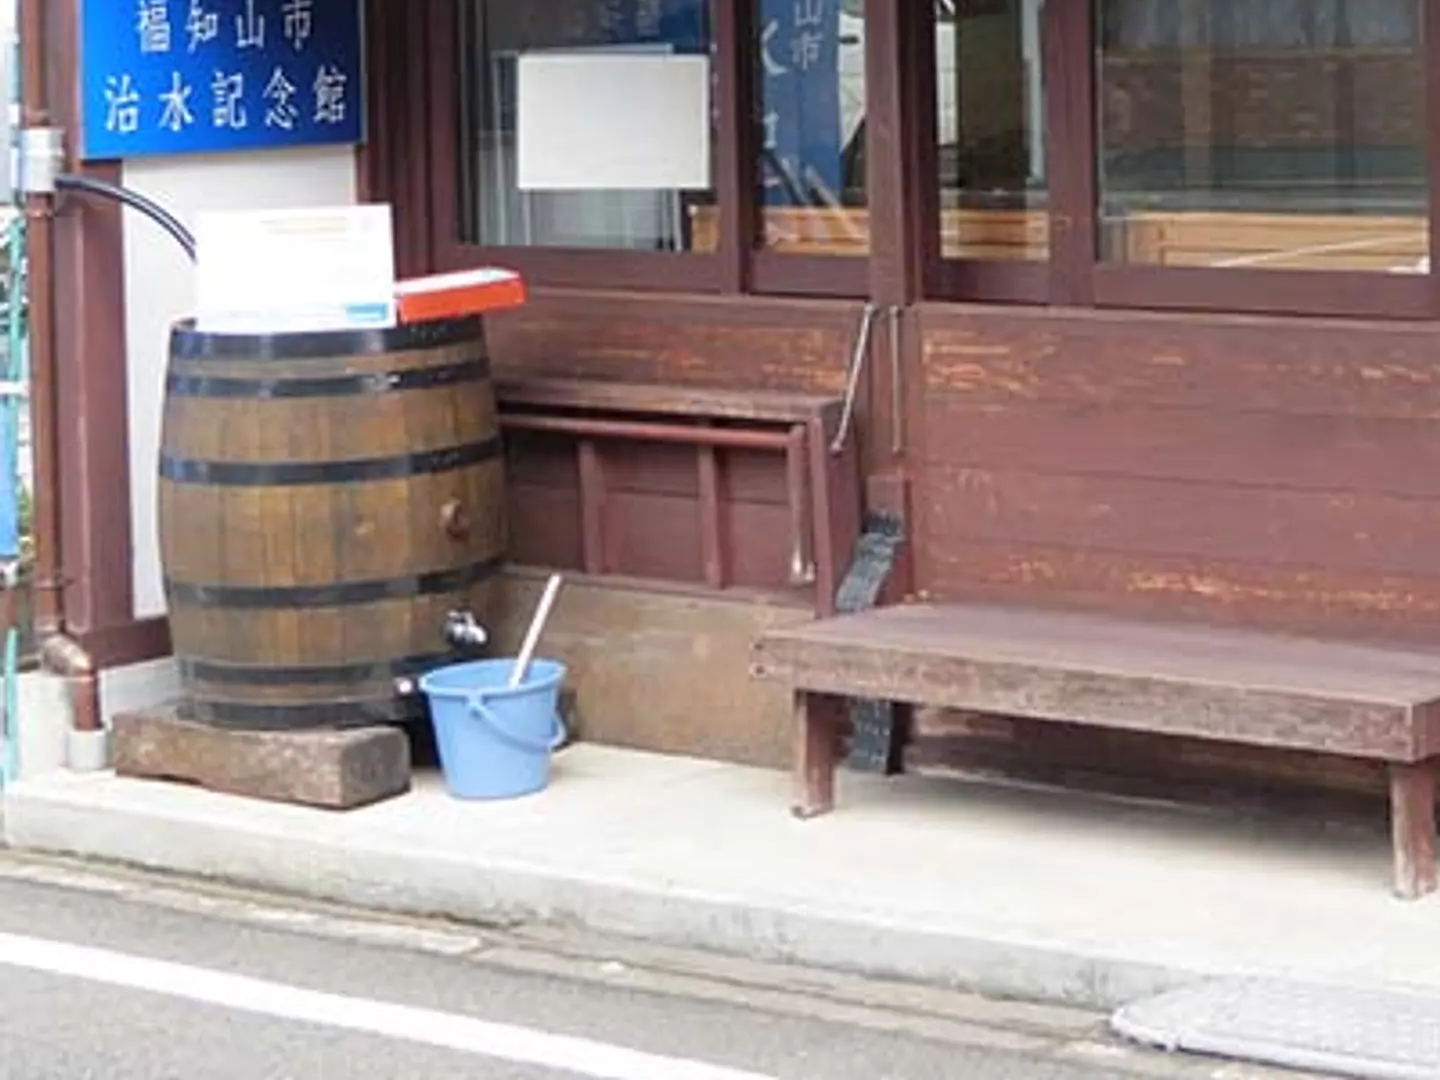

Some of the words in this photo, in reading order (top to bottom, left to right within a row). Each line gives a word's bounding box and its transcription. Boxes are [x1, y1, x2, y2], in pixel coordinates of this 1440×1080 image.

[103, 65, 348, 133] 治水記念館
